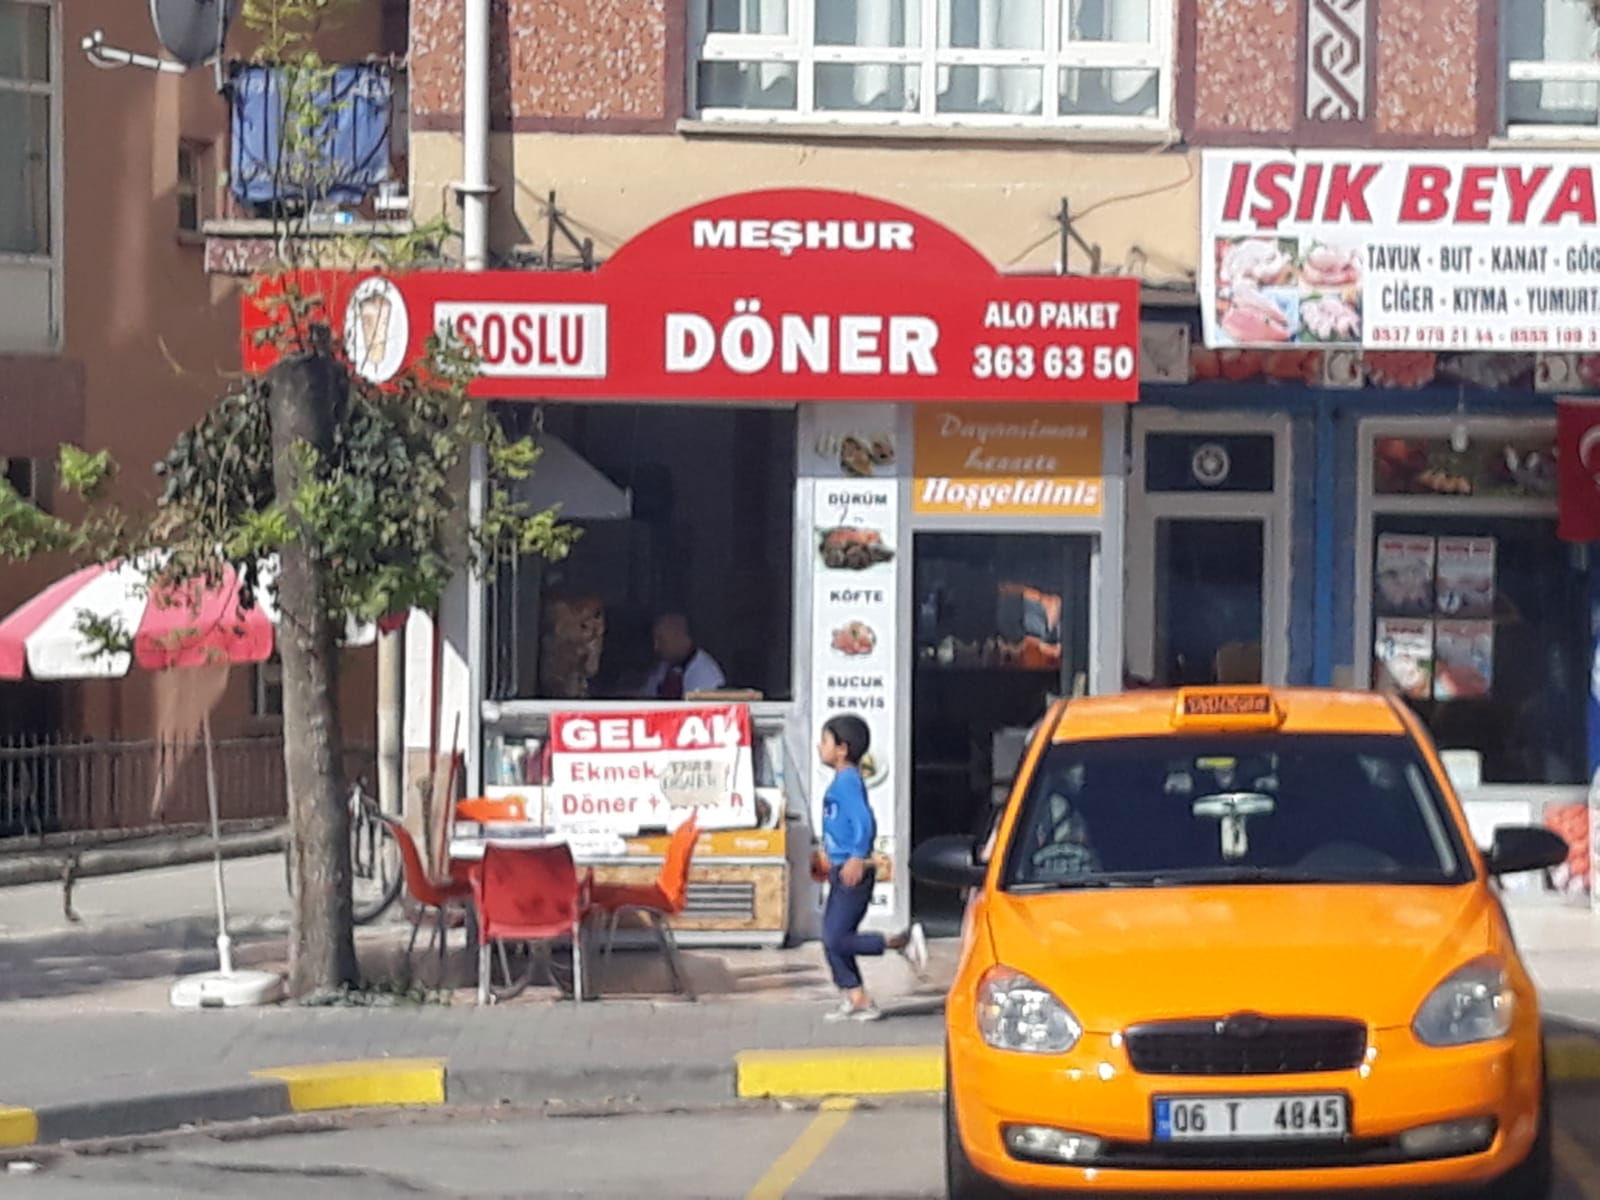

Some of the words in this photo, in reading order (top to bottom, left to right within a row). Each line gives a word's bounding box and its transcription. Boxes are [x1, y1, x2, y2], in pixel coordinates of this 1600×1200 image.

[1222, 160, 1383, 230] IŞIK
[1397, 164, 1598, 226] BEYA
[693, 219, 915, 256] MEŞHUR
[1367, 243, 1421, 272] TAVUK
[1440, 244, 1472, 274] BUT
[1491, 244, 1547, 273] KANAT
[1382, 279, 1433, 313] CİĞER
[1453, 286, 1508, 315] KIYMA
[1527, 286, 1600, 315] YUMURT
[984, 301, 1034, 328] ALO
[1039, 302, 1120, 329] PAKET
[456, 312, 584, 366] SOSLU
[664, 299, 940, 374] DÖNER
[972, 344, 1035, 379] 363
[1043, 344, 1084, 379] 63
[1093, 345, 1134, 379] 50
[828, 491, 887, 505] DÜRÜM
[922, 477, 1099, 511] Hoşgeldiniz
[830, 587, 883, 603] KÖFTE
[827, 695, 885, 709] SERVİS
[561, 717, 663, 750] GEL
[571, 761, 659, 783] Ekmek
[562, 793, 639, 815] Döner
[1174, 1104, 1206, 1132] 06
[1226, 1102, 1242, 1131] T
[1274, 1099, 1339, 1130] 4845
